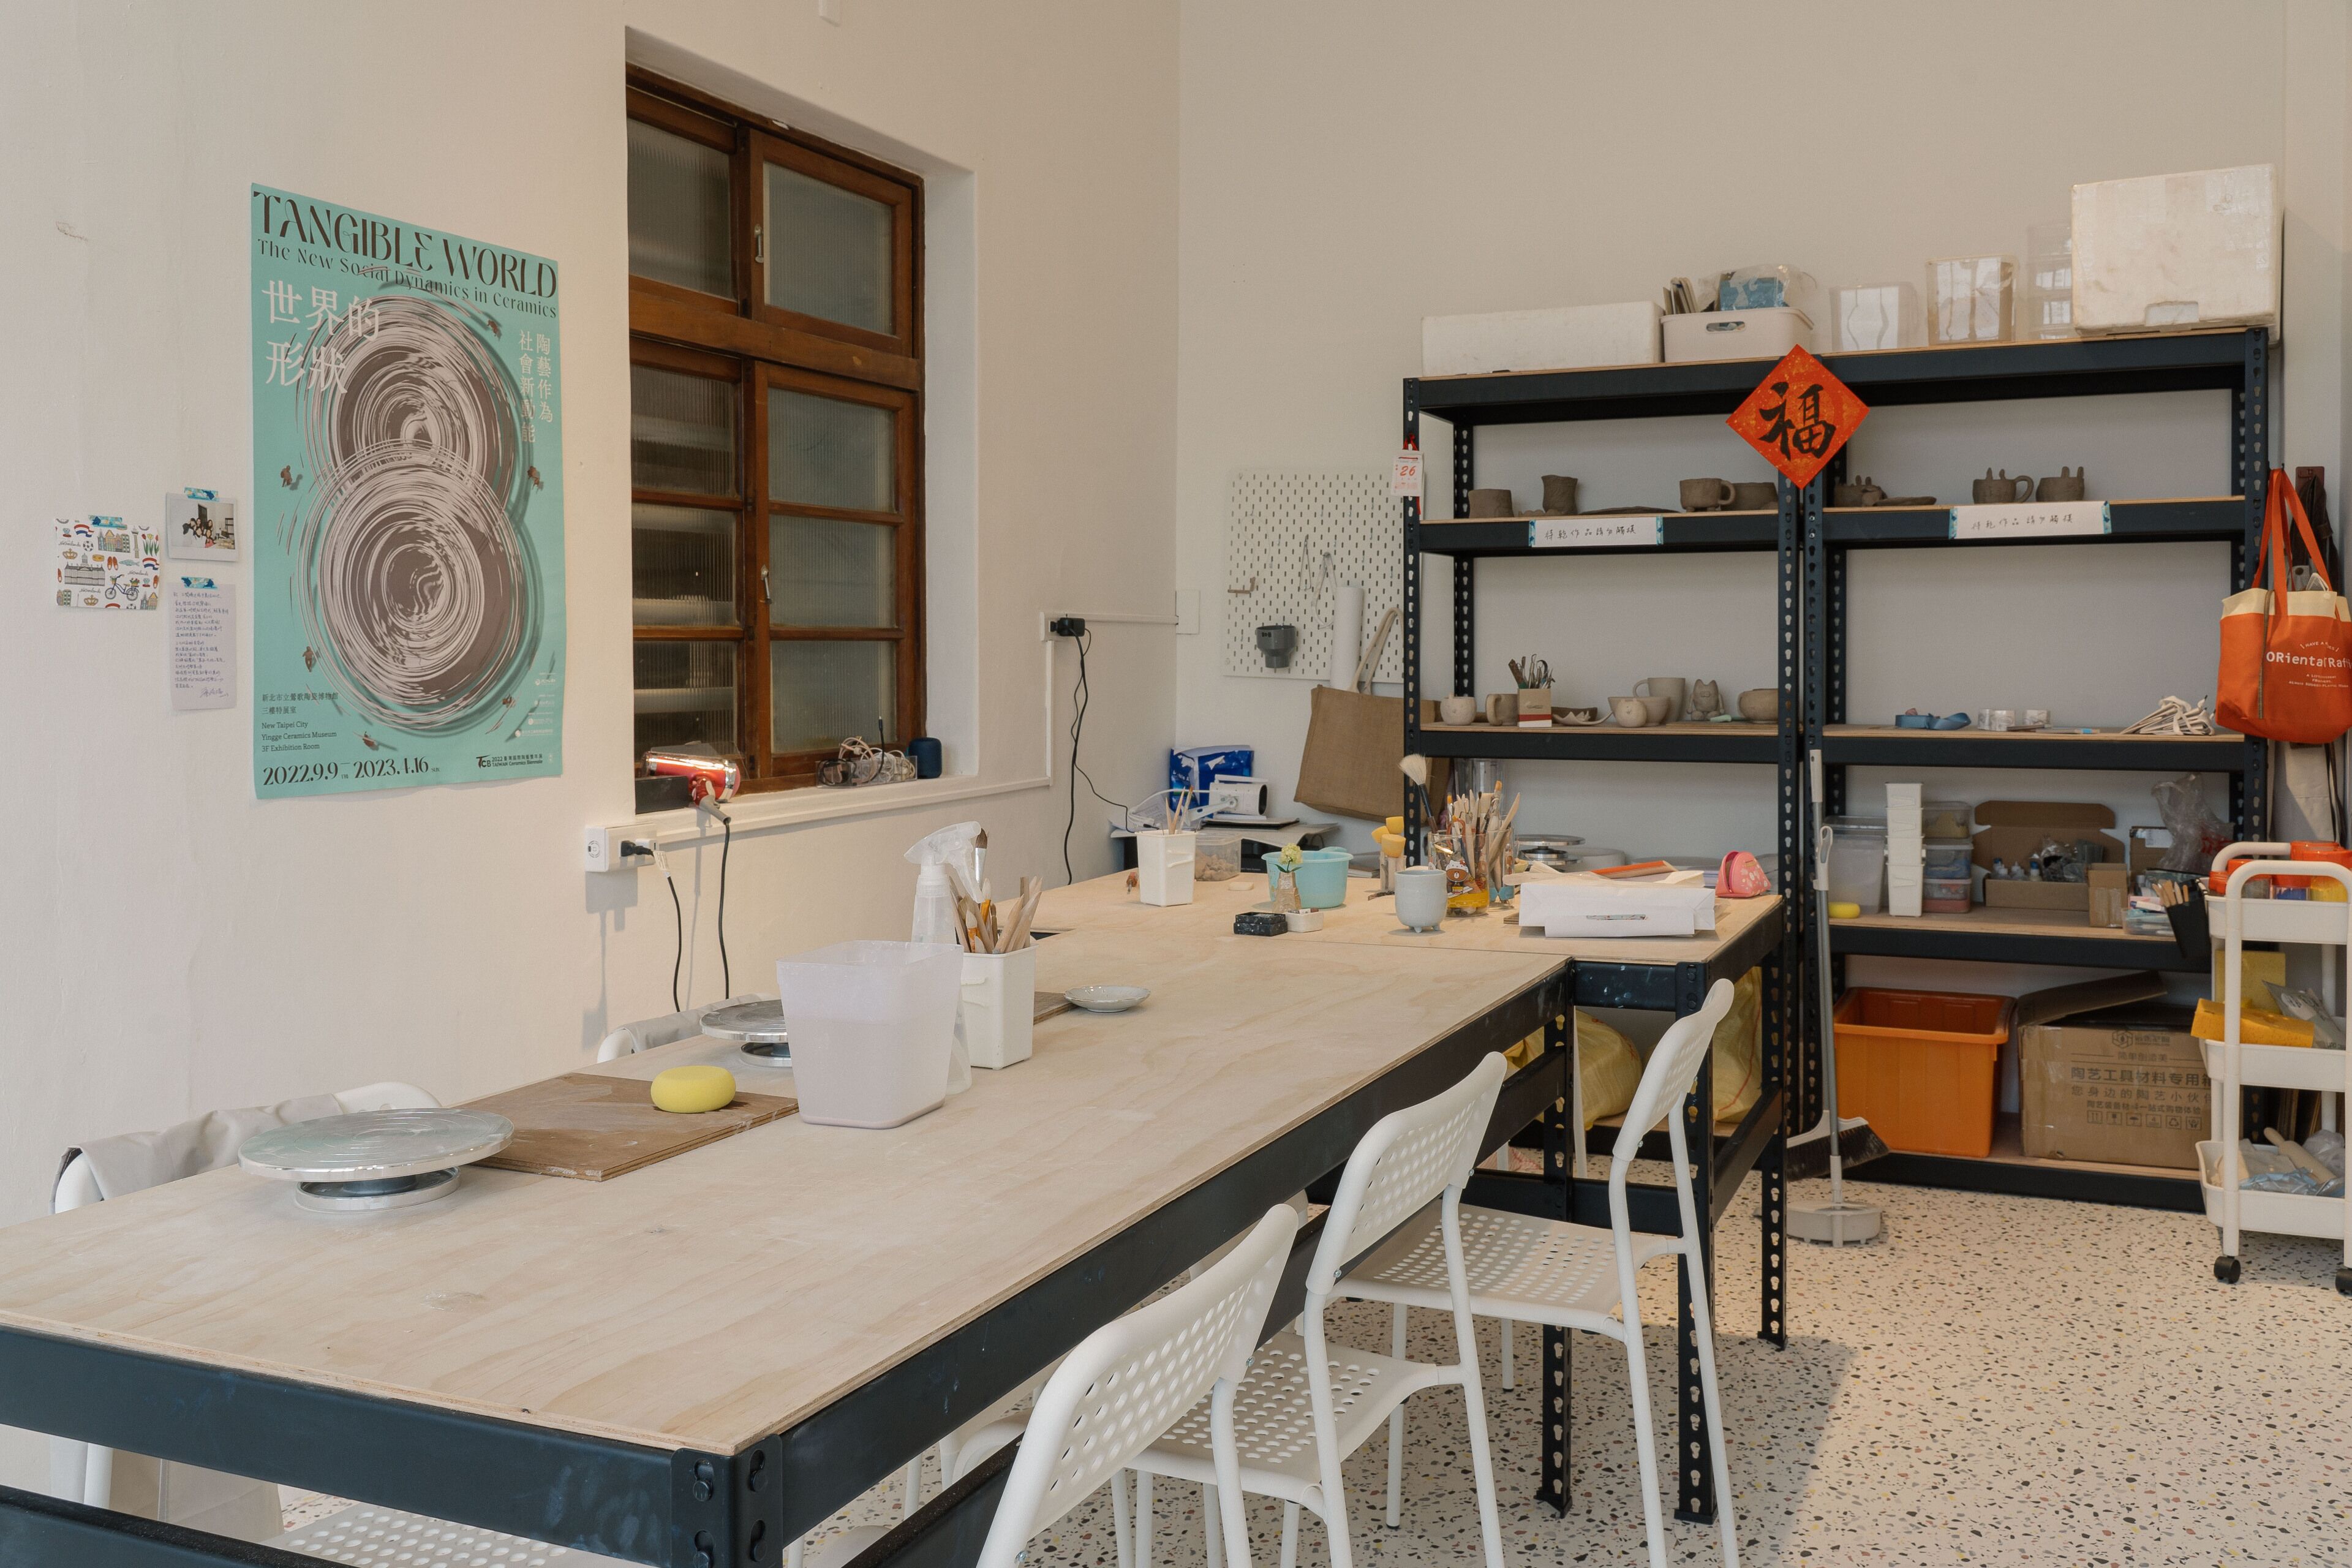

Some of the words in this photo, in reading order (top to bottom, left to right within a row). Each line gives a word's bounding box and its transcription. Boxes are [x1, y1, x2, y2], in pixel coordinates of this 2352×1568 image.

[253, 190, 433, 273] TANGIBLE
[442, 238, 557, 299] WORLD
[258, 238, 290, 260] The
[298, 249, 334, 270] New
[340, 258, 391, 283] Social
[395, 270, 469, 301] Dynamics
[474, 288, 488, 304] in
[493, 292, 557, 318] Ceramics
[261, 279, 380, 342] 世界的
[265, 340, 348, 394] 形狀
[536, 333, 554, 423] 陶藝作為
[1757, 381, 1837, 462] 福
[1400, 465, 1416, 477] 26
[276, 721, 295, 729] Taipei
[263, 761, 339, 786] 2022.9.9
[353, 756, 429, 778] 2023.4.16
[476, 755, 491, 769] TCB
